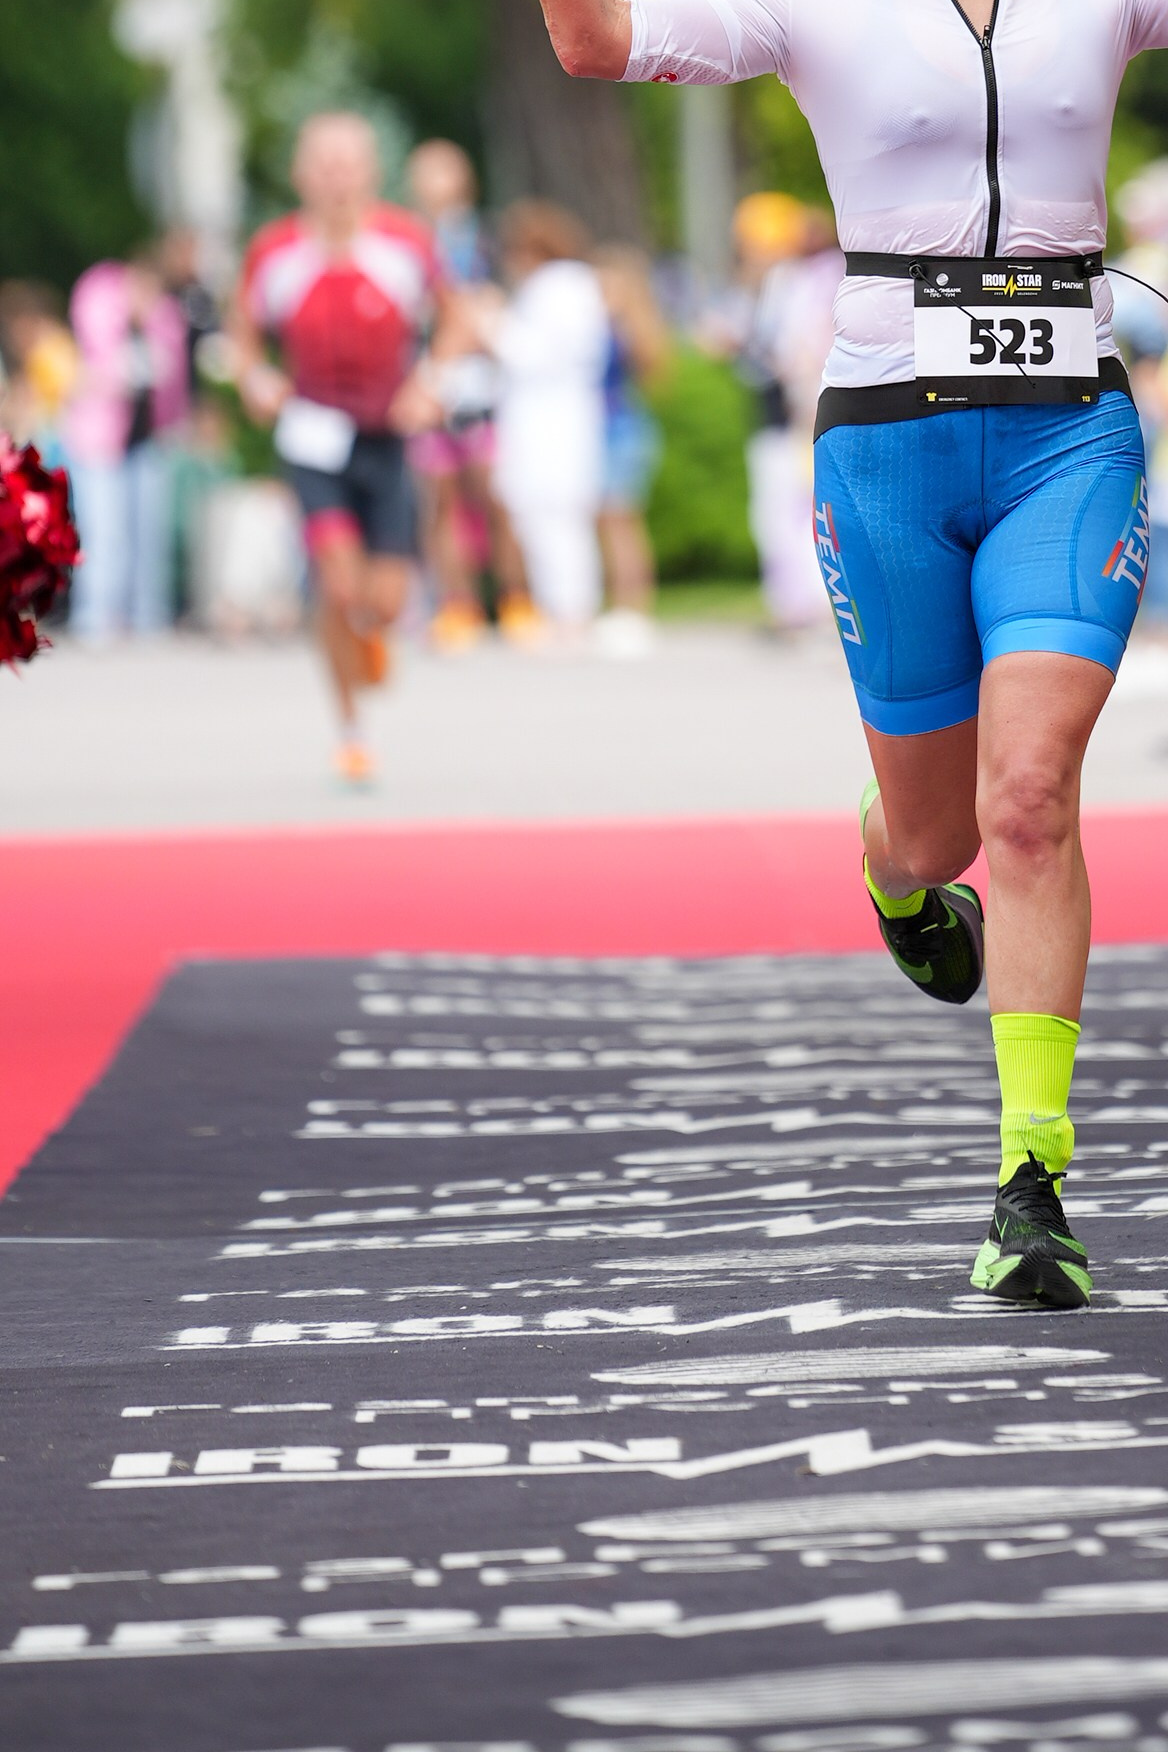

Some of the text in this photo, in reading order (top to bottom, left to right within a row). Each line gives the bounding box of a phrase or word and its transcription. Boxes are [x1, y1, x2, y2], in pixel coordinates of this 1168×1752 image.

[982, 274, 1042, 287] IRON STAR
[969, 318, 1054, 365] 523
[170, 1305, 676, 1345] IRON
[109, 1437, 681, 1479] IRON
[10, 1599, 682, 1655] IRON
